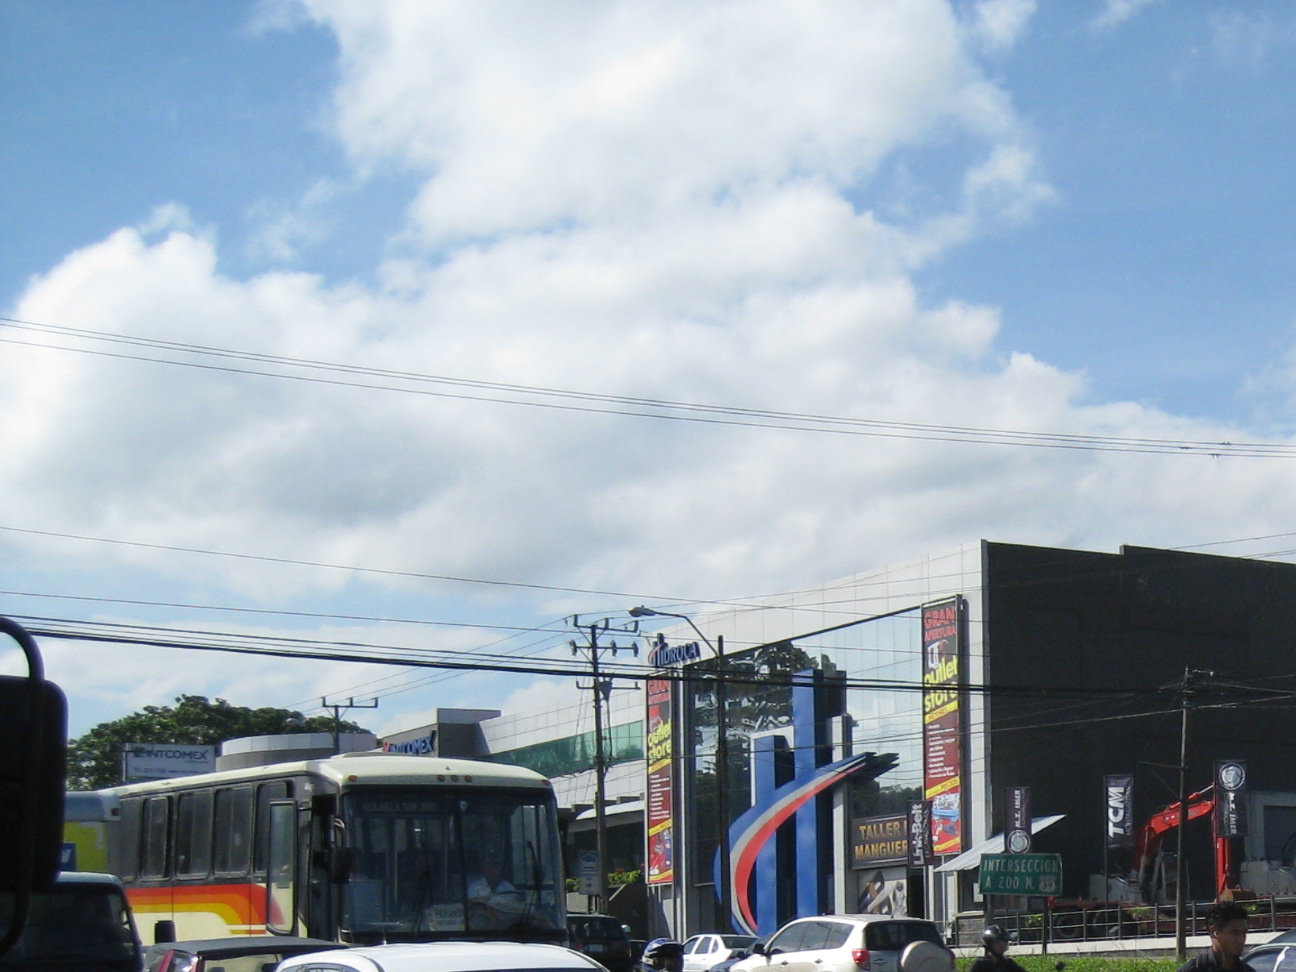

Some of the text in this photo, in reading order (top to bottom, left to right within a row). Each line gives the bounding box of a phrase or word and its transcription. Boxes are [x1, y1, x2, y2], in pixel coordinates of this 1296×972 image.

[924, 607, 956, 629] GRAN
[924, 655, 959, 688] outlet
[1107, 786, 1125, 838] TCM
[859, 822, 901, 840] TALLER
[911, 803, 923, 865] Link-Belt
[984, 859, 1059, 873] INTERSECCION
[985, 876, 992, 889] A
[998, 876, 1019, 889] 200
